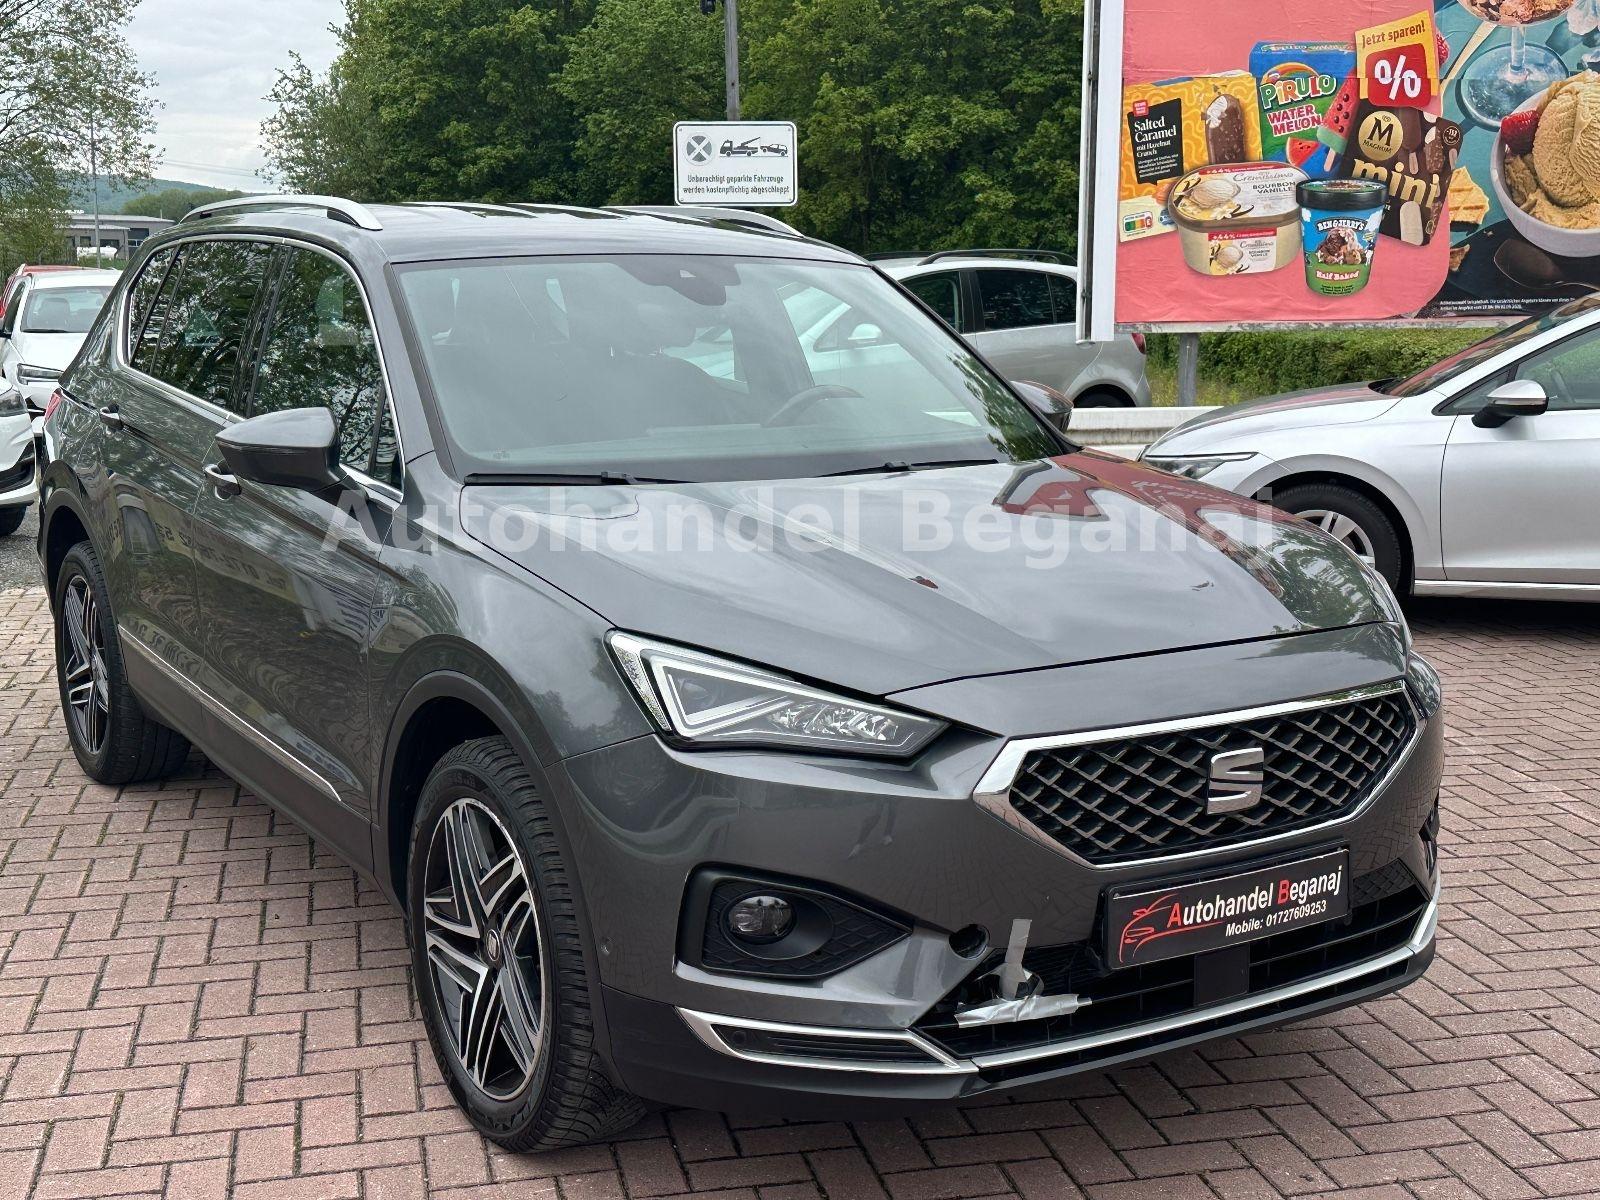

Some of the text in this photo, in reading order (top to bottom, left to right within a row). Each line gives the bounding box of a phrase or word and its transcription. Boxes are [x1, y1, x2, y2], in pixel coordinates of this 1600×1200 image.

[1362, 32, 1386, 49] Jetzt
[1387, 20, 1426, 43] sparen!
[1374, 54, 1421, 100] %
[1134, 115, 1165, 132] Salted
[1267, 104, 1316, 124] WATER
[1134, 125, 1177, 143] Caramel
[1273, 114, 1322, 137] MELON
[1367, 117, 1394, 147] M
[1362, 139, 1392, 153] MAGNUM
[687, 174, 784, 185] Unberechtigt geparkte Fahrzeuge
[1252, 181, 1296, 190] BOURBON
[1351, 158, 1440, 208] mini
[683, 185, 790, 195] werden kostenpflichtig abgeschleppt
[1257, 186, 1292, 194] VANILLE
[1166, 866, 1343, 929] Autohandel Beganaj
[1225, 900, 1327, 938] Mobile: 01727609253
